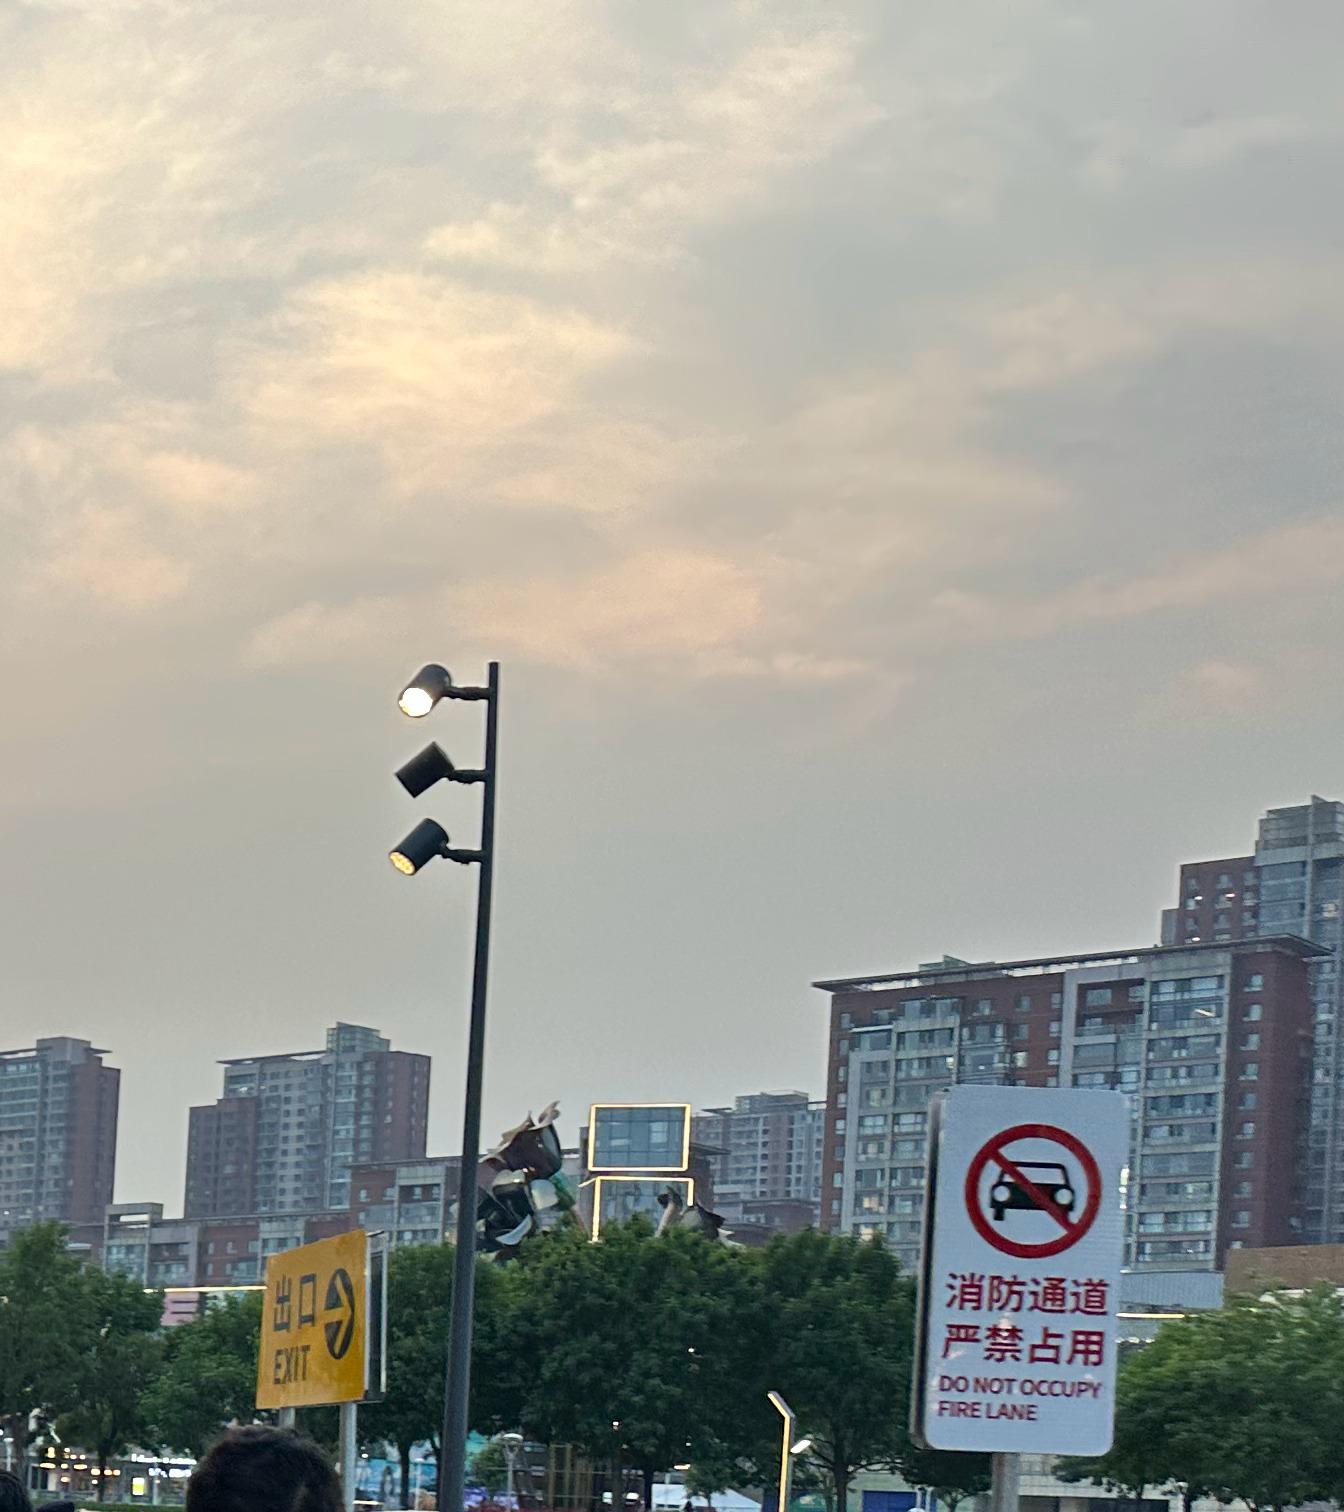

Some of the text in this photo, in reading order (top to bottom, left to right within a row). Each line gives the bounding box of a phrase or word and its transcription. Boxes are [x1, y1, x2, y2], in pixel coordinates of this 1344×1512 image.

[273, 1272, 317, 1333] 出口
[944, 1272, 1110, 1317] 消防通道
[273, 1344, 311, 1385] EXIT
[942, 1323, 1106, 1367] 严禁占用
[938, 1375, 1102, 1399] DO NOT OCCUPY
[937, 1400, 1038, 1421] FIRE LANE
